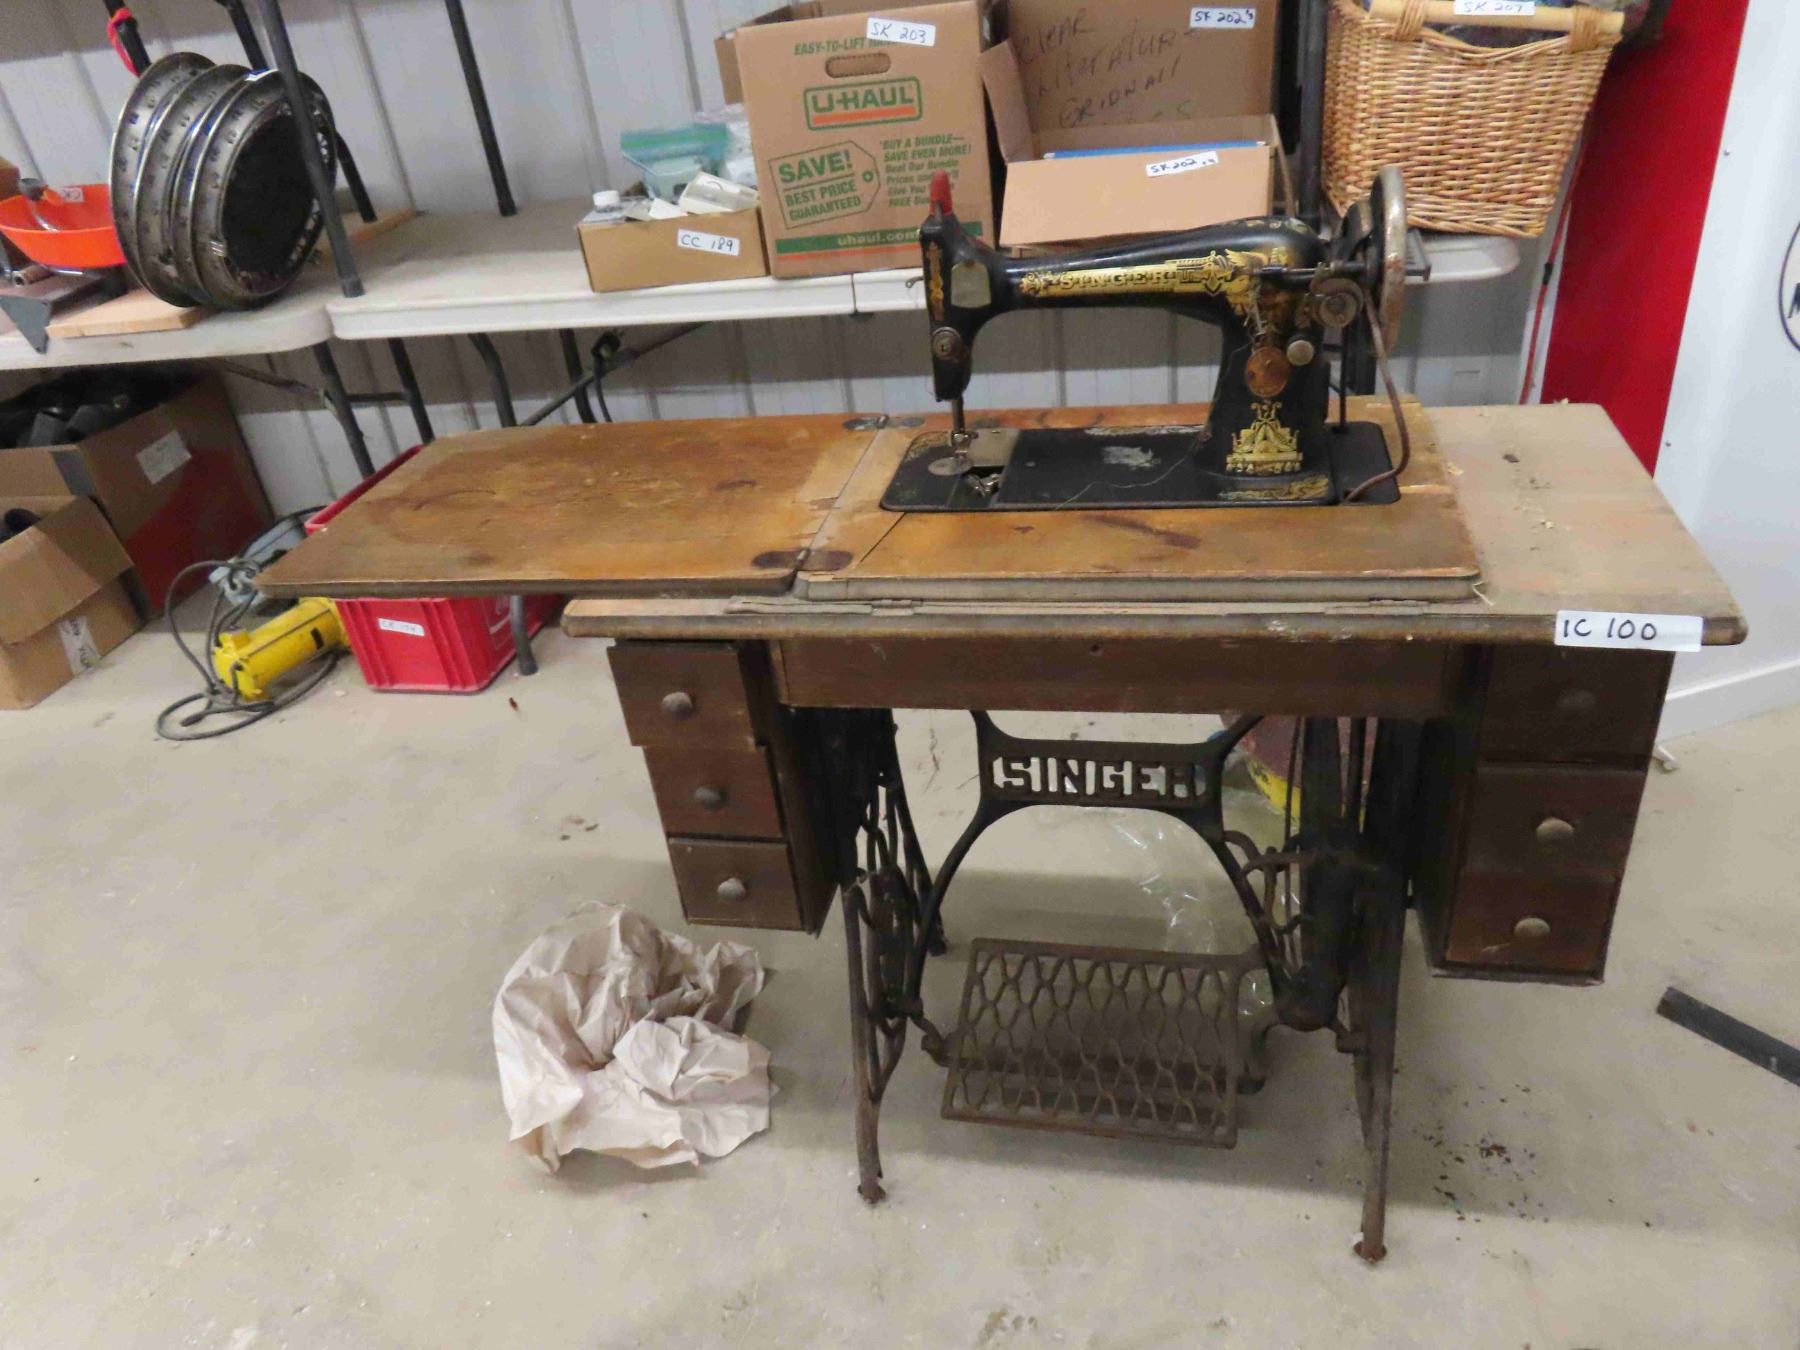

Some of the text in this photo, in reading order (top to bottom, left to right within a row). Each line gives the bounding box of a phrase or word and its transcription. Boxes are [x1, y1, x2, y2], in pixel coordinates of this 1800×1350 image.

[870, 22, 893, 38] SK
[899, 26, 927, 44] 203
[794, 37, 865, 55] EASY-TO-LIFT
[811, 86, 915, 113] U-HAUL
[884, 150, 908, 161] SAVE
[911, 148, 936, 159] EVEN
[778, 150, 853, 184] SAVE!
[784, 180, 857, 207] BEST PRICE
[789, 195, 862, 221] GUARANTEED
[681, 234, 733, 252] CC 189
[1060, 269, 1170, 290] SINGER
[1607, 617, 1657, 640] 100
[994, 757, 1206, 799] SINGER
